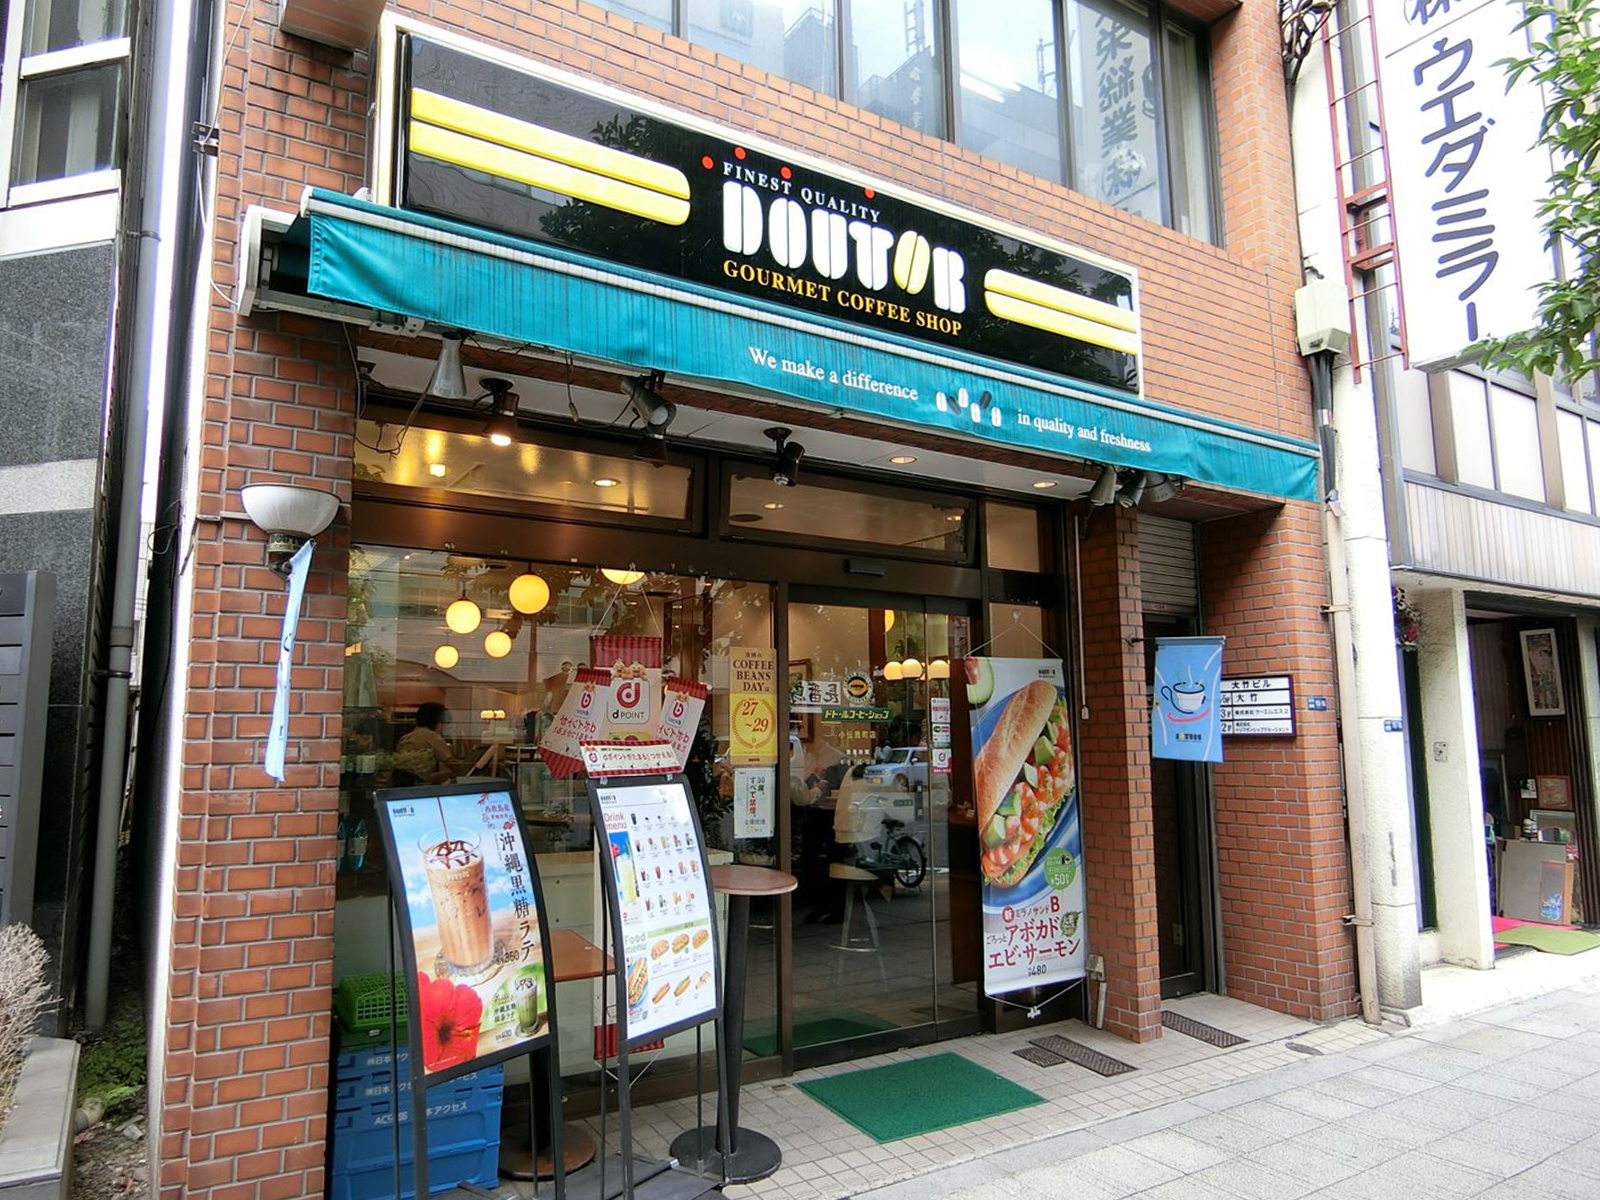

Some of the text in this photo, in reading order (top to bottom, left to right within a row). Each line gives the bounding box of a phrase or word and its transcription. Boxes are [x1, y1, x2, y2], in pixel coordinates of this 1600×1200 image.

[723, 161, 881, 223] FINEST QUALITY
[1413, 38, 1500, 342] ウエダミラー
[721, 180, 967, 315] DOUTOR
[723, 259, 963, 337] GOURMET COFFEE SHOP
[748, 346, 1152, 453] We make a difference in quality and freshness
[733, 659, 774, 670] COFFEE
[736, 670, 771, 681] BEANS
[743, 681, 763, 693] DAY
[1231, 678, 1272, 690] 大竹ビル
[1236, 692, 1259, 703] 大竹
[612, 710, 645, 719] d POINT
[742, 700, 758, 716] 27
[603, 811, 625, 823] Drink
[606, 820, 628, 831] menu
[499, 832, 536, 963] 沖縄黒糖ラテ
[1050, 896, 1060, 913] B
[625, 931, 646, 945] Food
[1005, 916, 1060, 946] アボカド
[626, 941, 647, 954] menu
[988, 938, 1081, 969] エビ・サーモン
